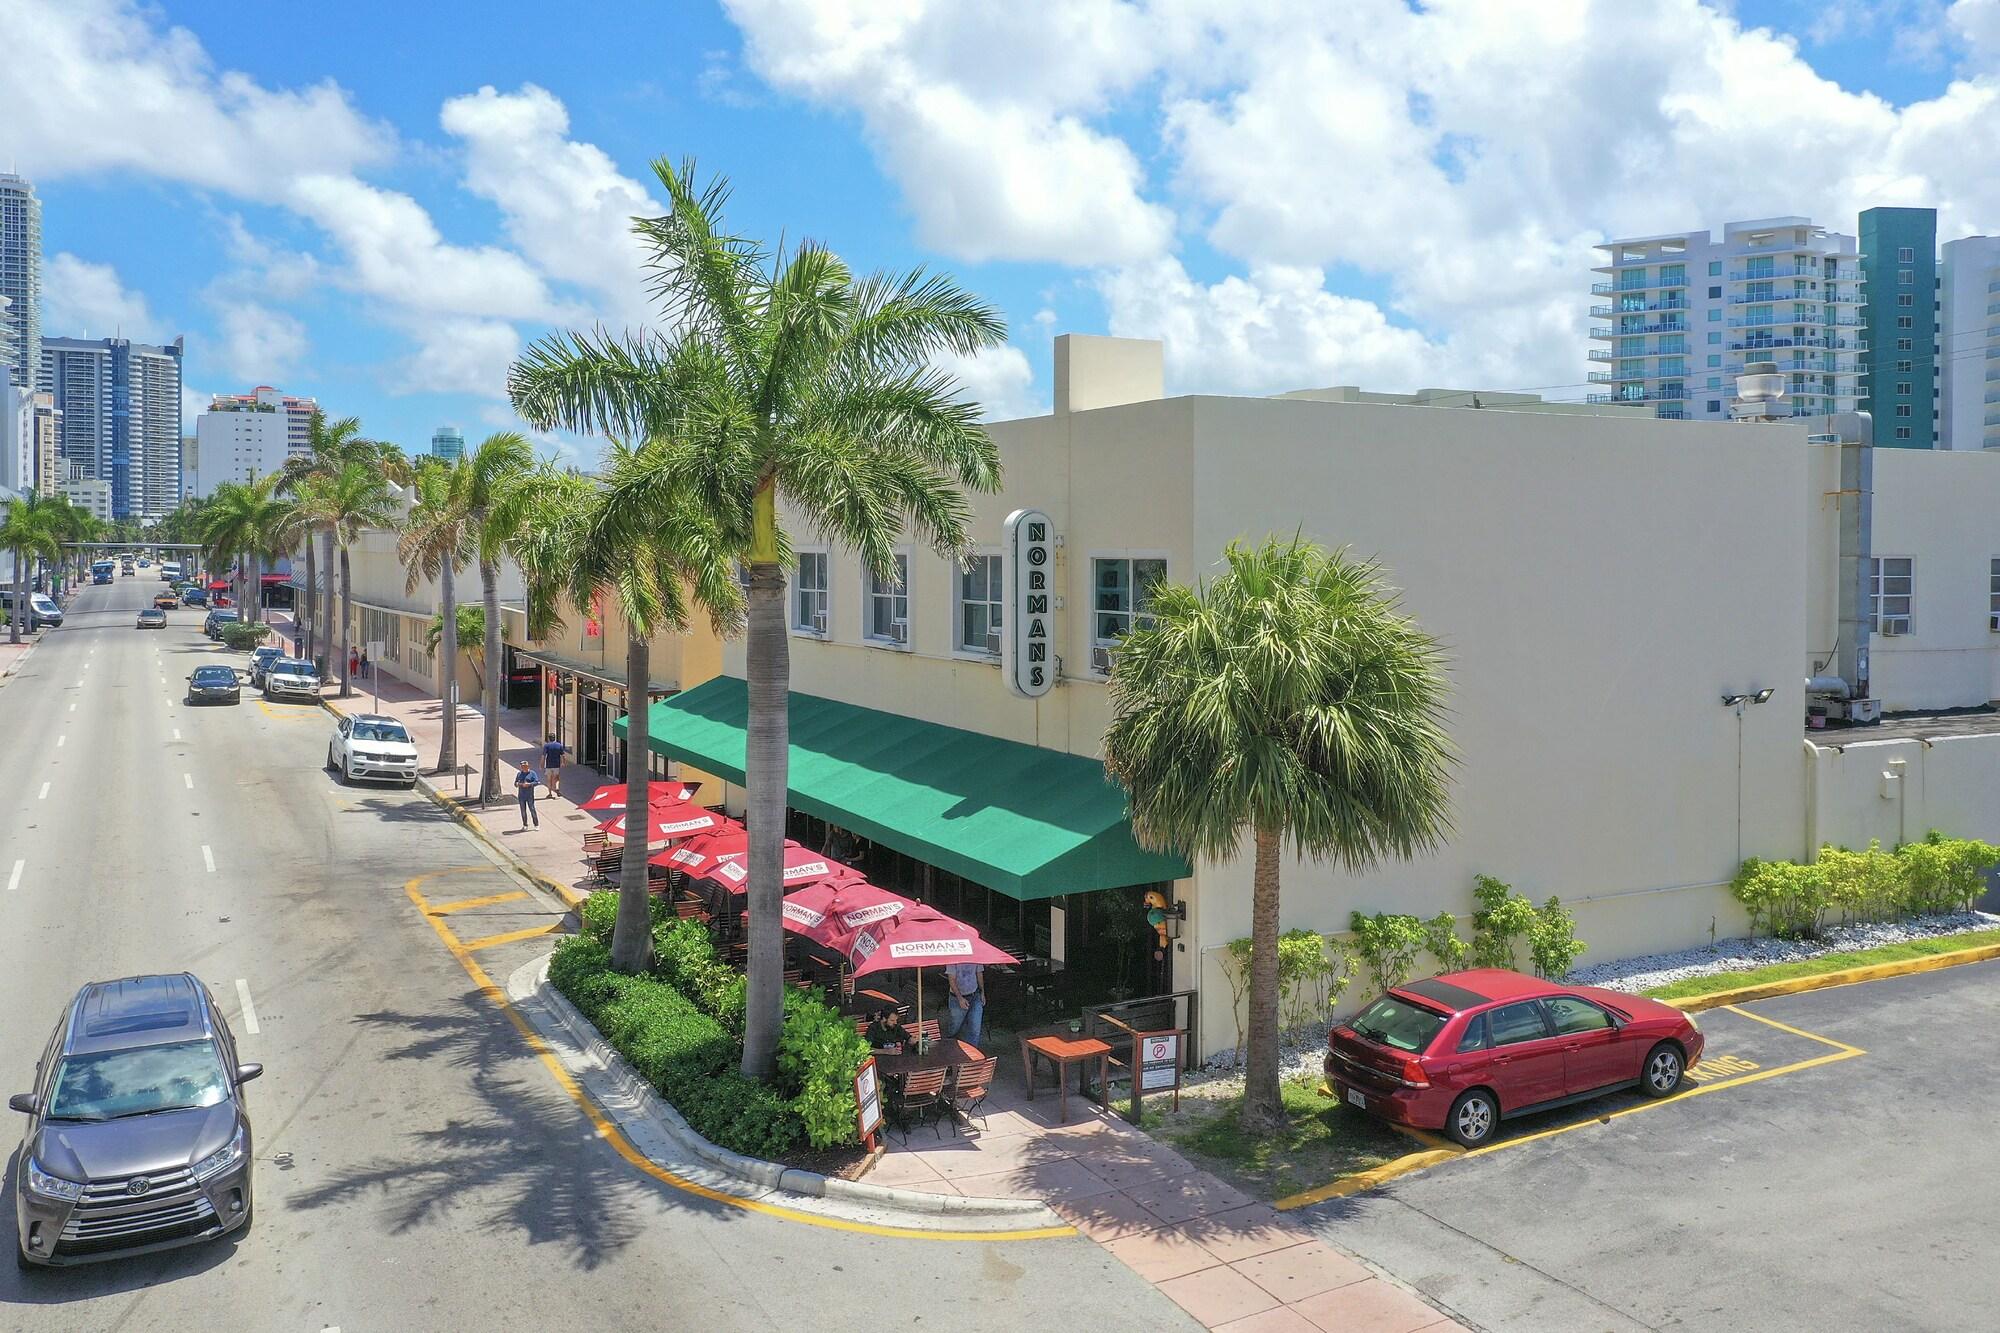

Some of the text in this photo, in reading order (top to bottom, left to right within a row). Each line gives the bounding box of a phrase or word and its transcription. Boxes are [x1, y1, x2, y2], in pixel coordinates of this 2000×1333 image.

[1027, 522, 1048, 687] NORMANS
[784, 863, 824, 876] RMAN'S
[846, 903, 901, 921] NORMAN'S
[895, 941, 967, 952] NORMAN'S
